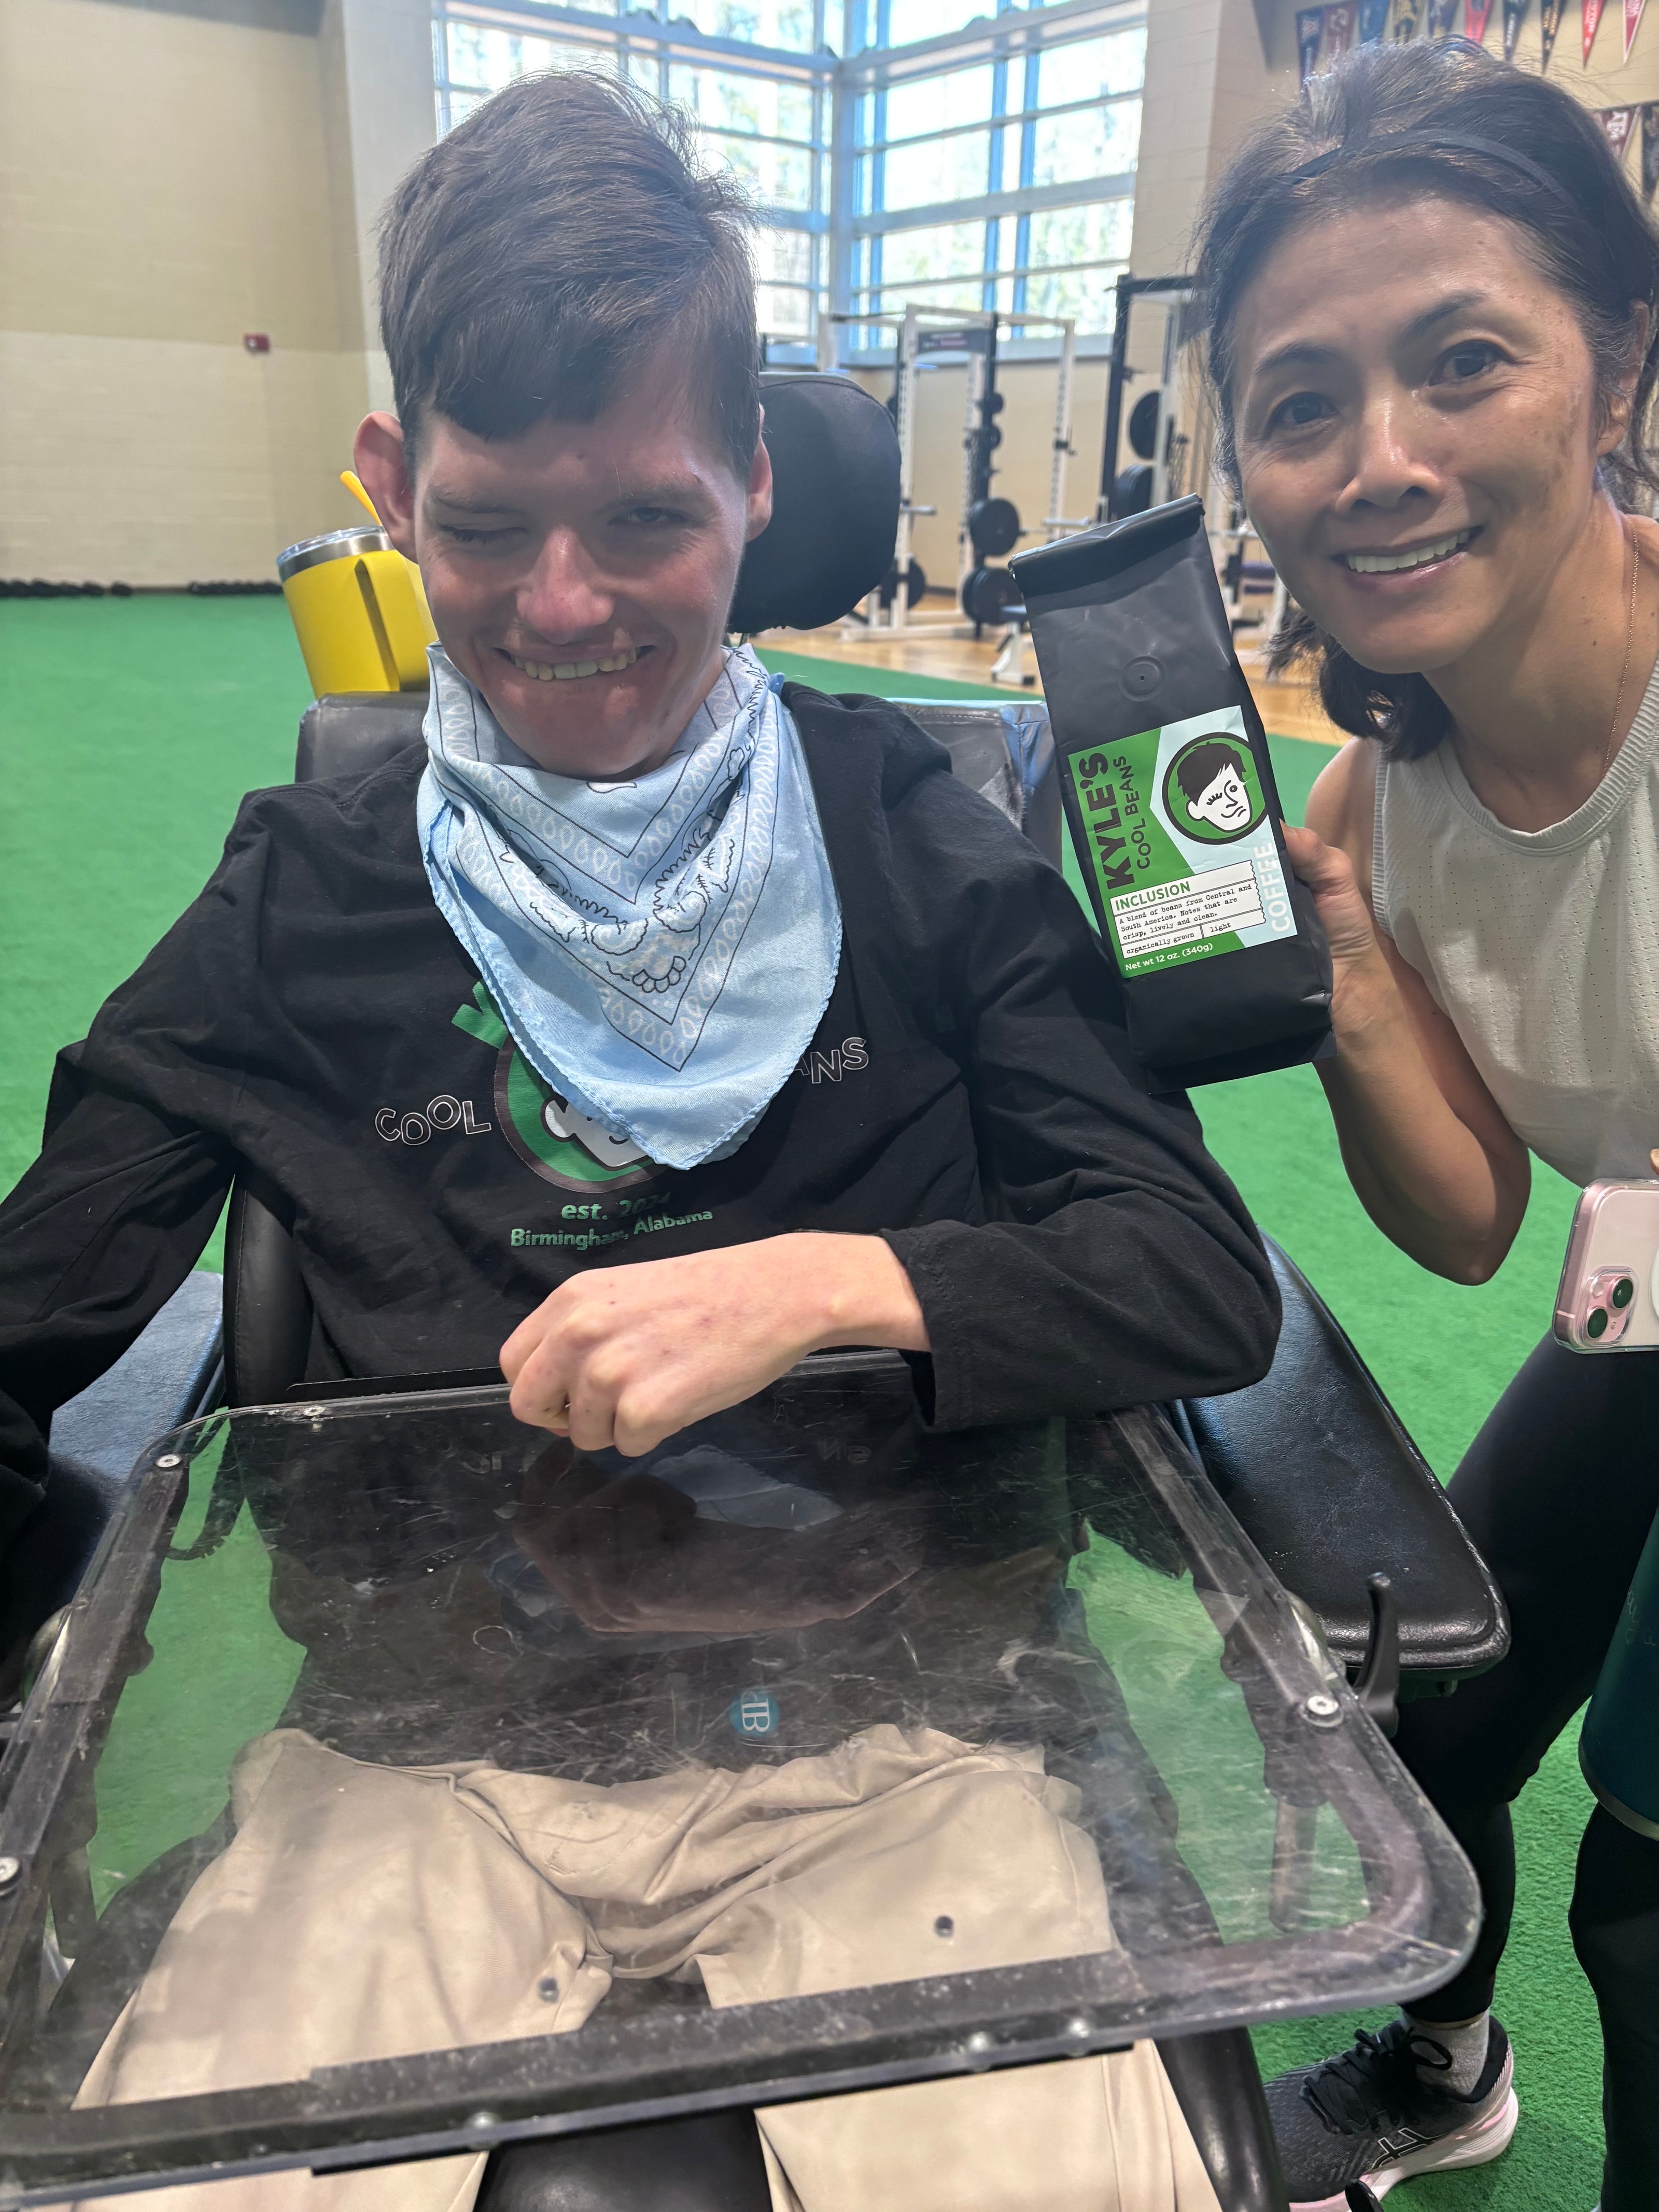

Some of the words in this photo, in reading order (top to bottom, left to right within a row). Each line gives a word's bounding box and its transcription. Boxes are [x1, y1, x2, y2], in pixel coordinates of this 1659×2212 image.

[1113, 756, 1140, 816] BEANS
[1079, 753, 1135, 890] KYLE'S
[1131, 818, 1151, 869] COOL
[1115, 881, 1191, 911] INCLUSION
[1127, 912, 1147, 922] blend
[1161, 904, 1183, 912] beans
[1186, 898, 1203, 906] from
[1205, 889, 1235, 901] Central
[1238, 884, 1253, 892] and
[1253, 843, 1291, 932] COFFEE
[1121, 922, 1142, 932] South
[1144, 914, 1176, 926] America.
[1180, 907, 1201, 917] Notes
[1204, 900, 1221, 910] that
[1123, 931, 1146, 940] crisp,
[1150, 923, 1174, 933] lively
[1177, 918, 1191, 926] and
[1193, 912, 1217, 922] clean.
[1210, 922, 1231, 933] light
[1125, 961, 1142, 971] Net
[1142, 958, 1155, 966] wt
[1155, 955, 1166, 963] 12
[1182, 943, 1213, 957] (340g)
[1127, 939, 1171, 954] organically
[1173, 933, 1195, 943] grown
[375, 1094, 492, 1145] COOL
[561, 1203, 609, 1220] est.
[511, 1228, 630, 1251] Birmingham,
[634, 1209, 713, 1235] Alabama
